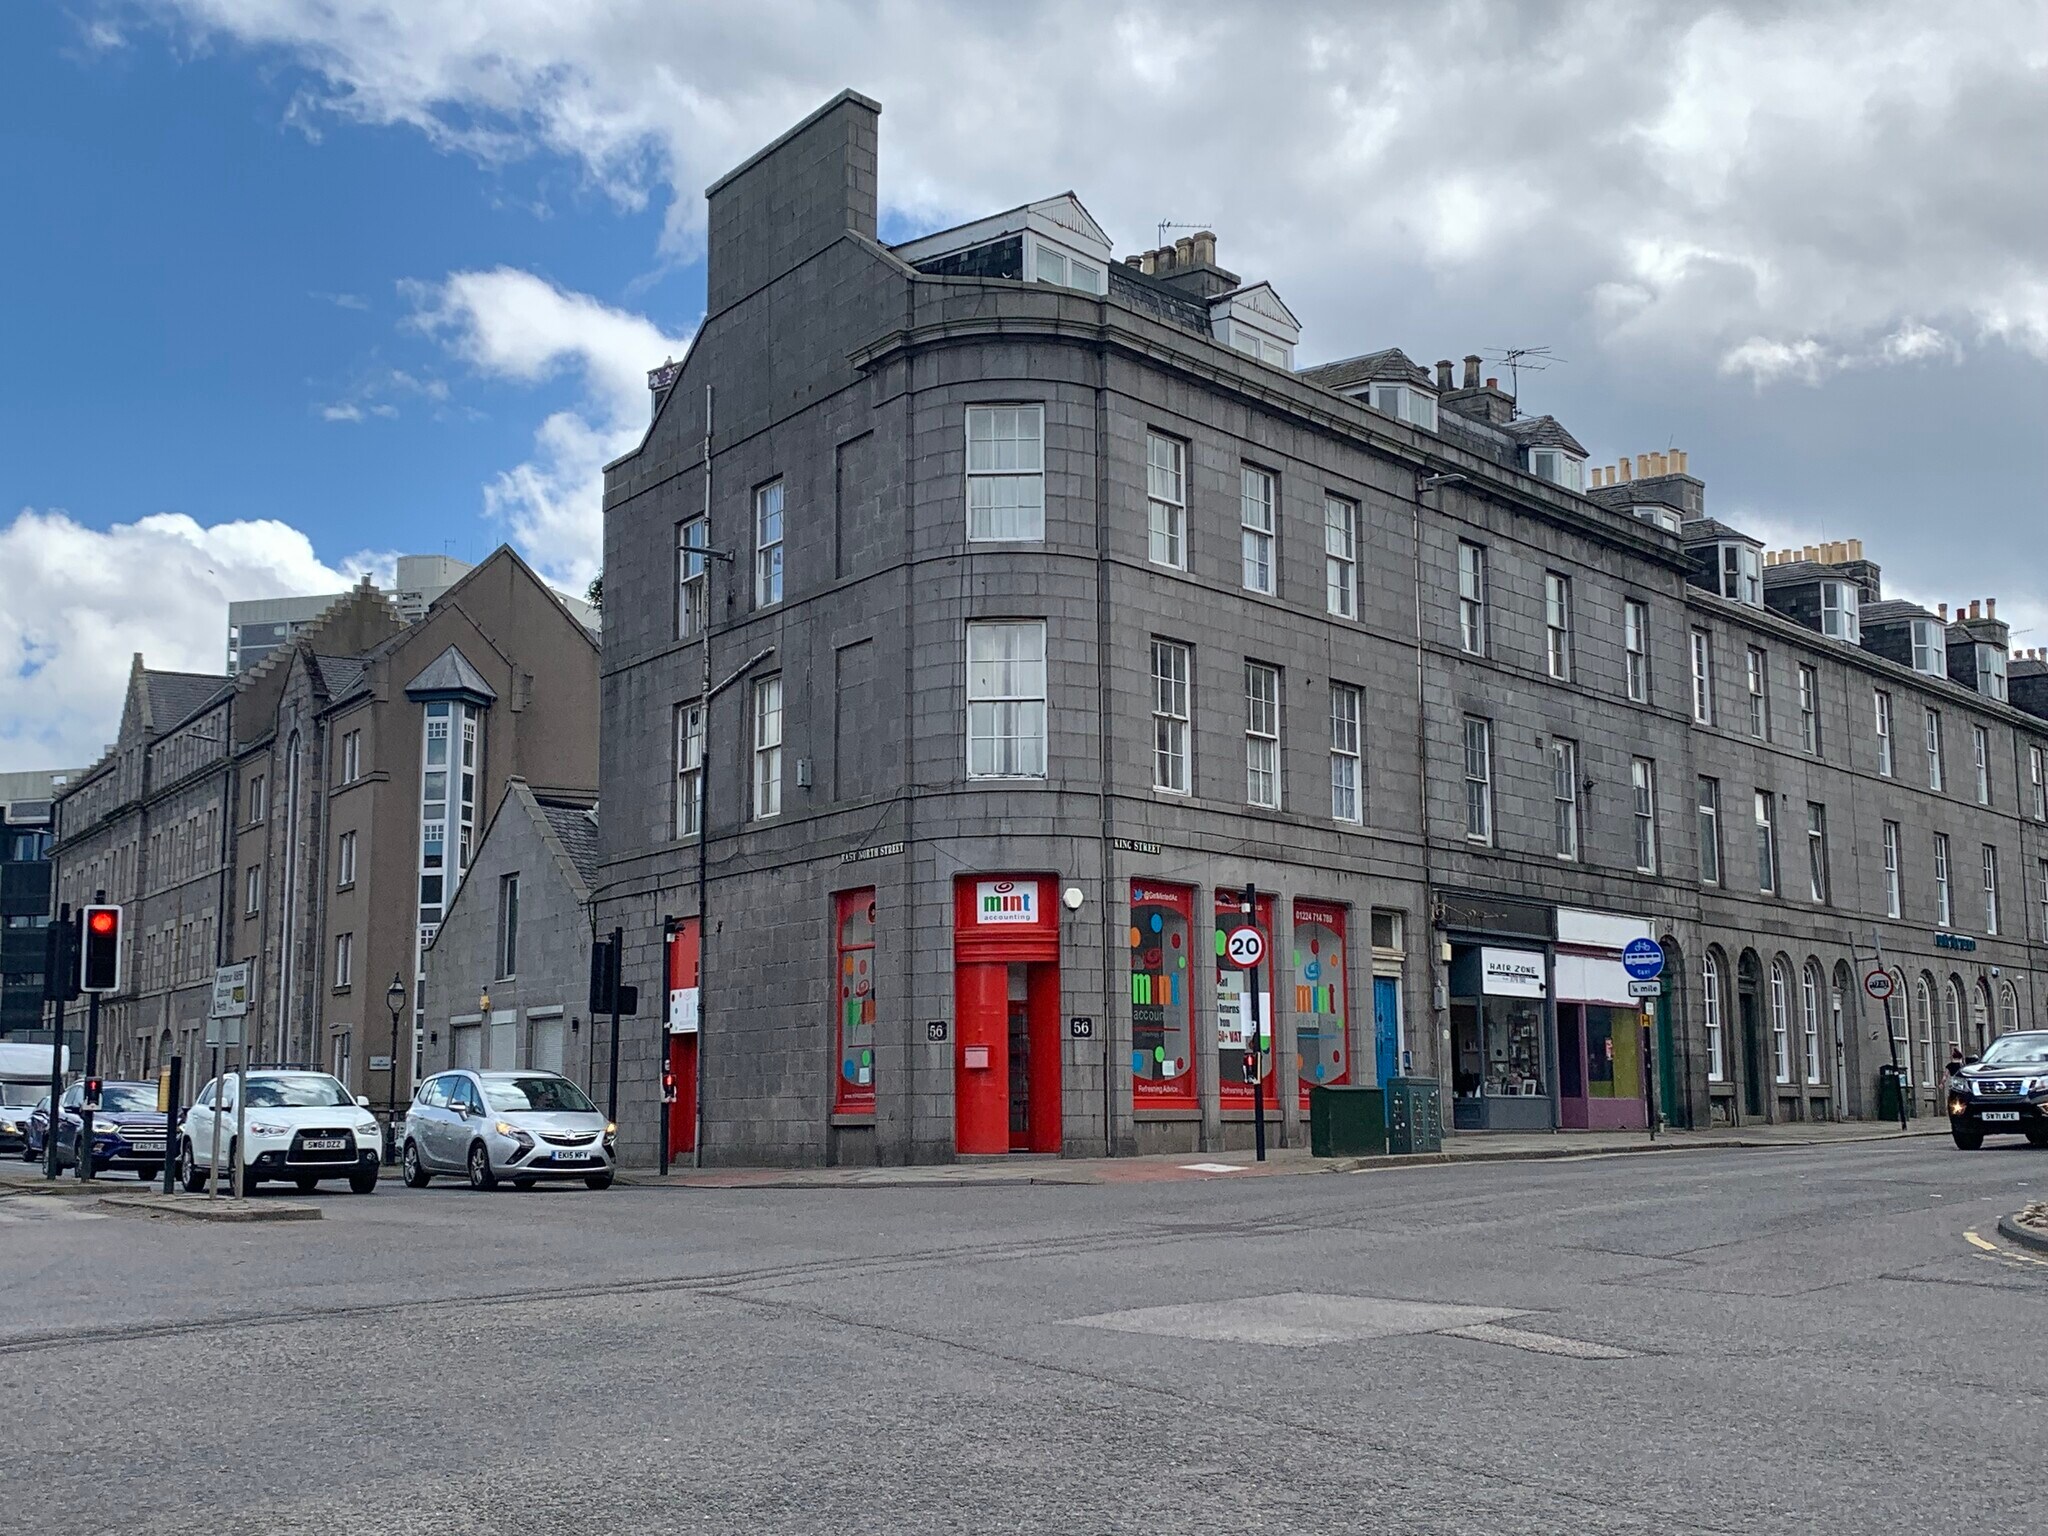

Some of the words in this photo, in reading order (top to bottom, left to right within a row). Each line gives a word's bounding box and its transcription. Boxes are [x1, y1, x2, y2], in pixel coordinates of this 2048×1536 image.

[841, 851, 857, 863] EAST
[858, 846, 879, 861] NORTH
[880, 842, 904, 856] STREET
[1114, 839, 1132, 850] KING
[1133, 841, 1161, 854] STREET
[984, 894, 1031, 912] mint
[1231, 938, 1259, 955] 20
[1489, 963, 1511, 972] HAIR
[1514, 965, 1536, 974] ZONE
[1132, 972, 1180, 1007] mint
[1641, 985, 1658, 993] mile
[1296, 984, 1336, 1014] mint
[929, 1024, 943, 1038] 56
[1073, 1021, 1089, 1034] 56
[558, 1151, 574, 1160] EK15
